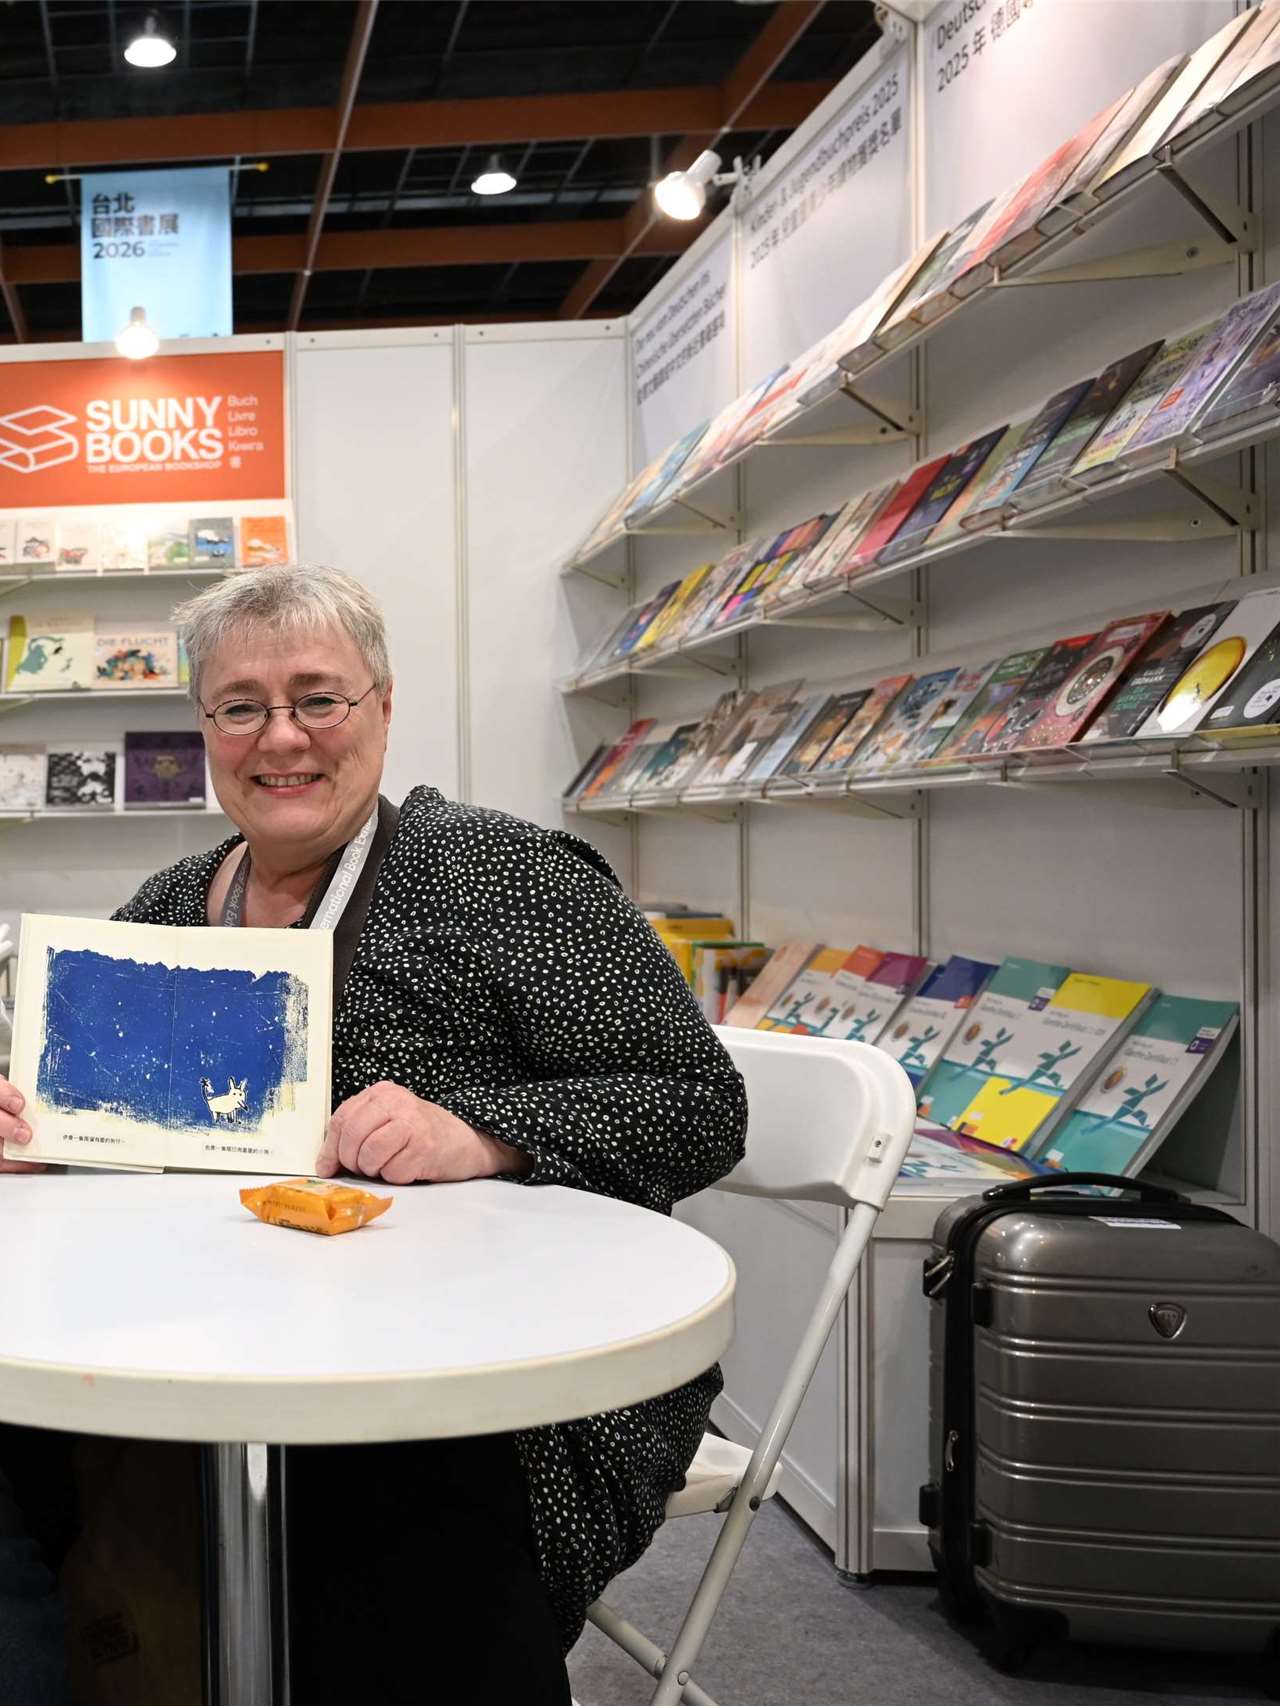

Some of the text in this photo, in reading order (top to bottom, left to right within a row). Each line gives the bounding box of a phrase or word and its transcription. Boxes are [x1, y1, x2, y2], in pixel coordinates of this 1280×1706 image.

[938, 44, 969, 93] 2025
[972, 26, 987, 56] 年
[872, 73, 898, 116] 2025
[92, 192, 135, 214] 台北
[91, 213, 179, 239] 國際書展
[93, 241, 145, 259] 2026
[228, 394, 259, 408] Buch
[85, 396, 223, 432] SUNNY
[228, 411, 256, 422] Livre
[228, 426, 258, 437] Libro
[85, 427, 224, 464] BOOKS
[87, 460, 222, 474] THE EUROPEAN BOOKSHOP
[97, 636, 169, 647] DIE FLUCHT
[343, 846, 363, 871] Book
[229, 882, 244, 910] Book
